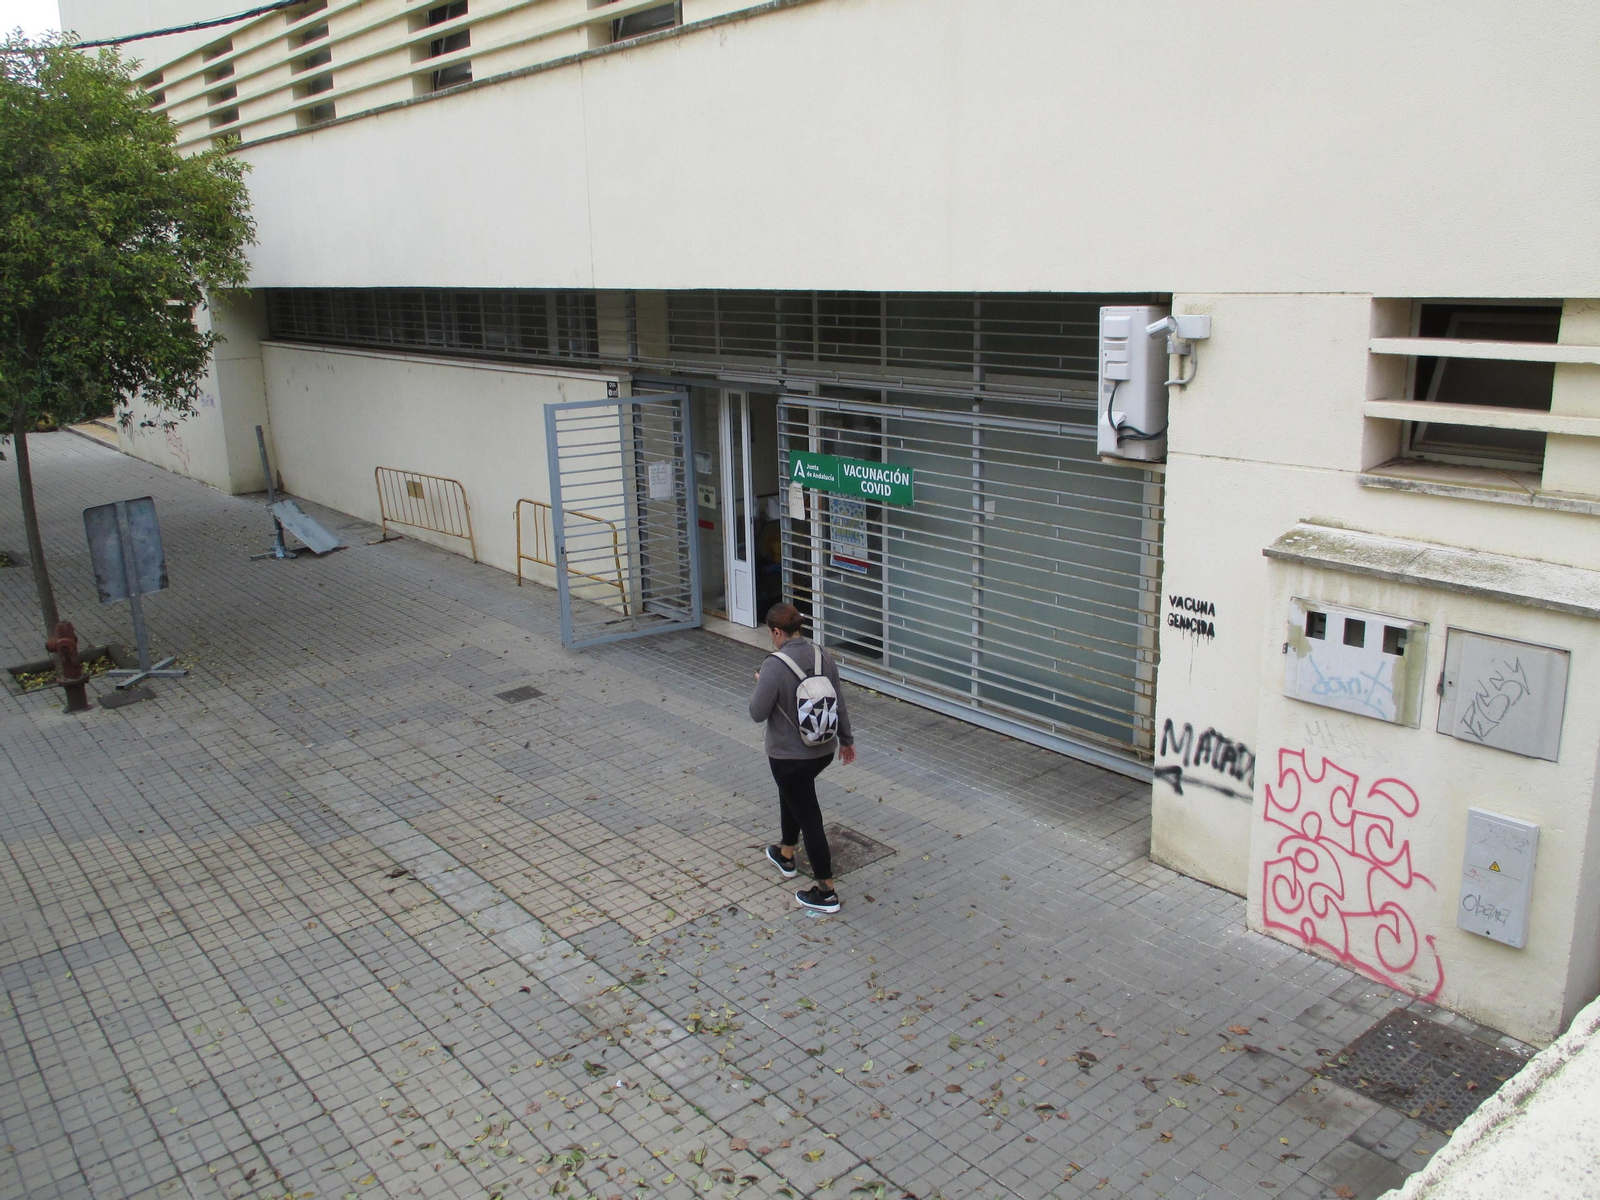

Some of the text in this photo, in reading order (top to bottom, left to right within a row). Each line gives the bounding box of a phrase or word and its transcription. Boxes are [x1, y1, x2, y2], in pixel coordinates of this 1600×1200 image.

[806, 463, 819, 471] Junta
[812, 472, 835, 482] Andalucía
[843, 463, 910, 486] VACUNACIÓN
[860, 480, 892, 497] COVID
[1168, 594, 1216, 618] VACUNA
[1462, 893, 1512, 927] Obama
